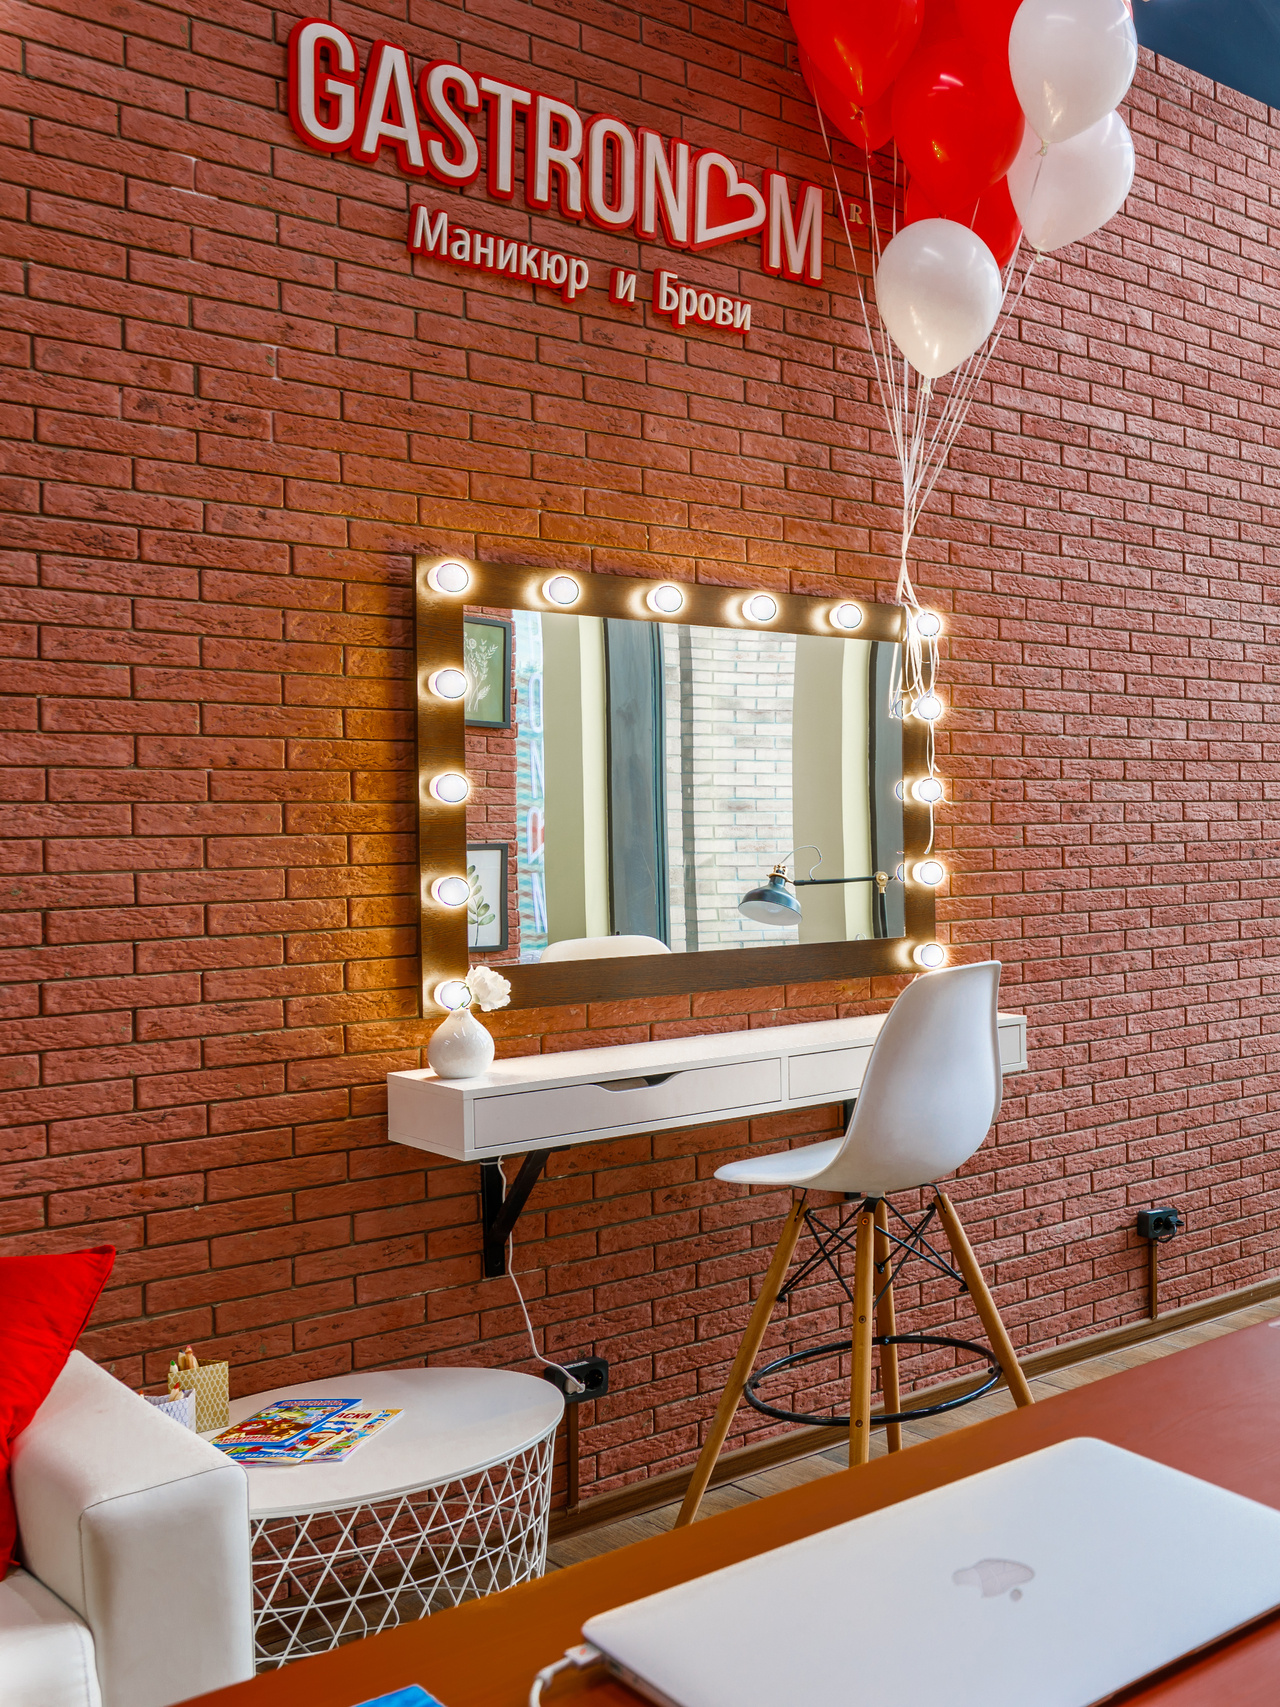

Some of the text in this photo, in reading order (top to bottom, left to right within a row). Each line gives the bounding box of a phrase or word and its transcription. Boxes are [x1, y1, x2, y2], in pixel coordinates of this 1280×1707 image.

[412, 205, 751, 331] Маникюр и Брови
